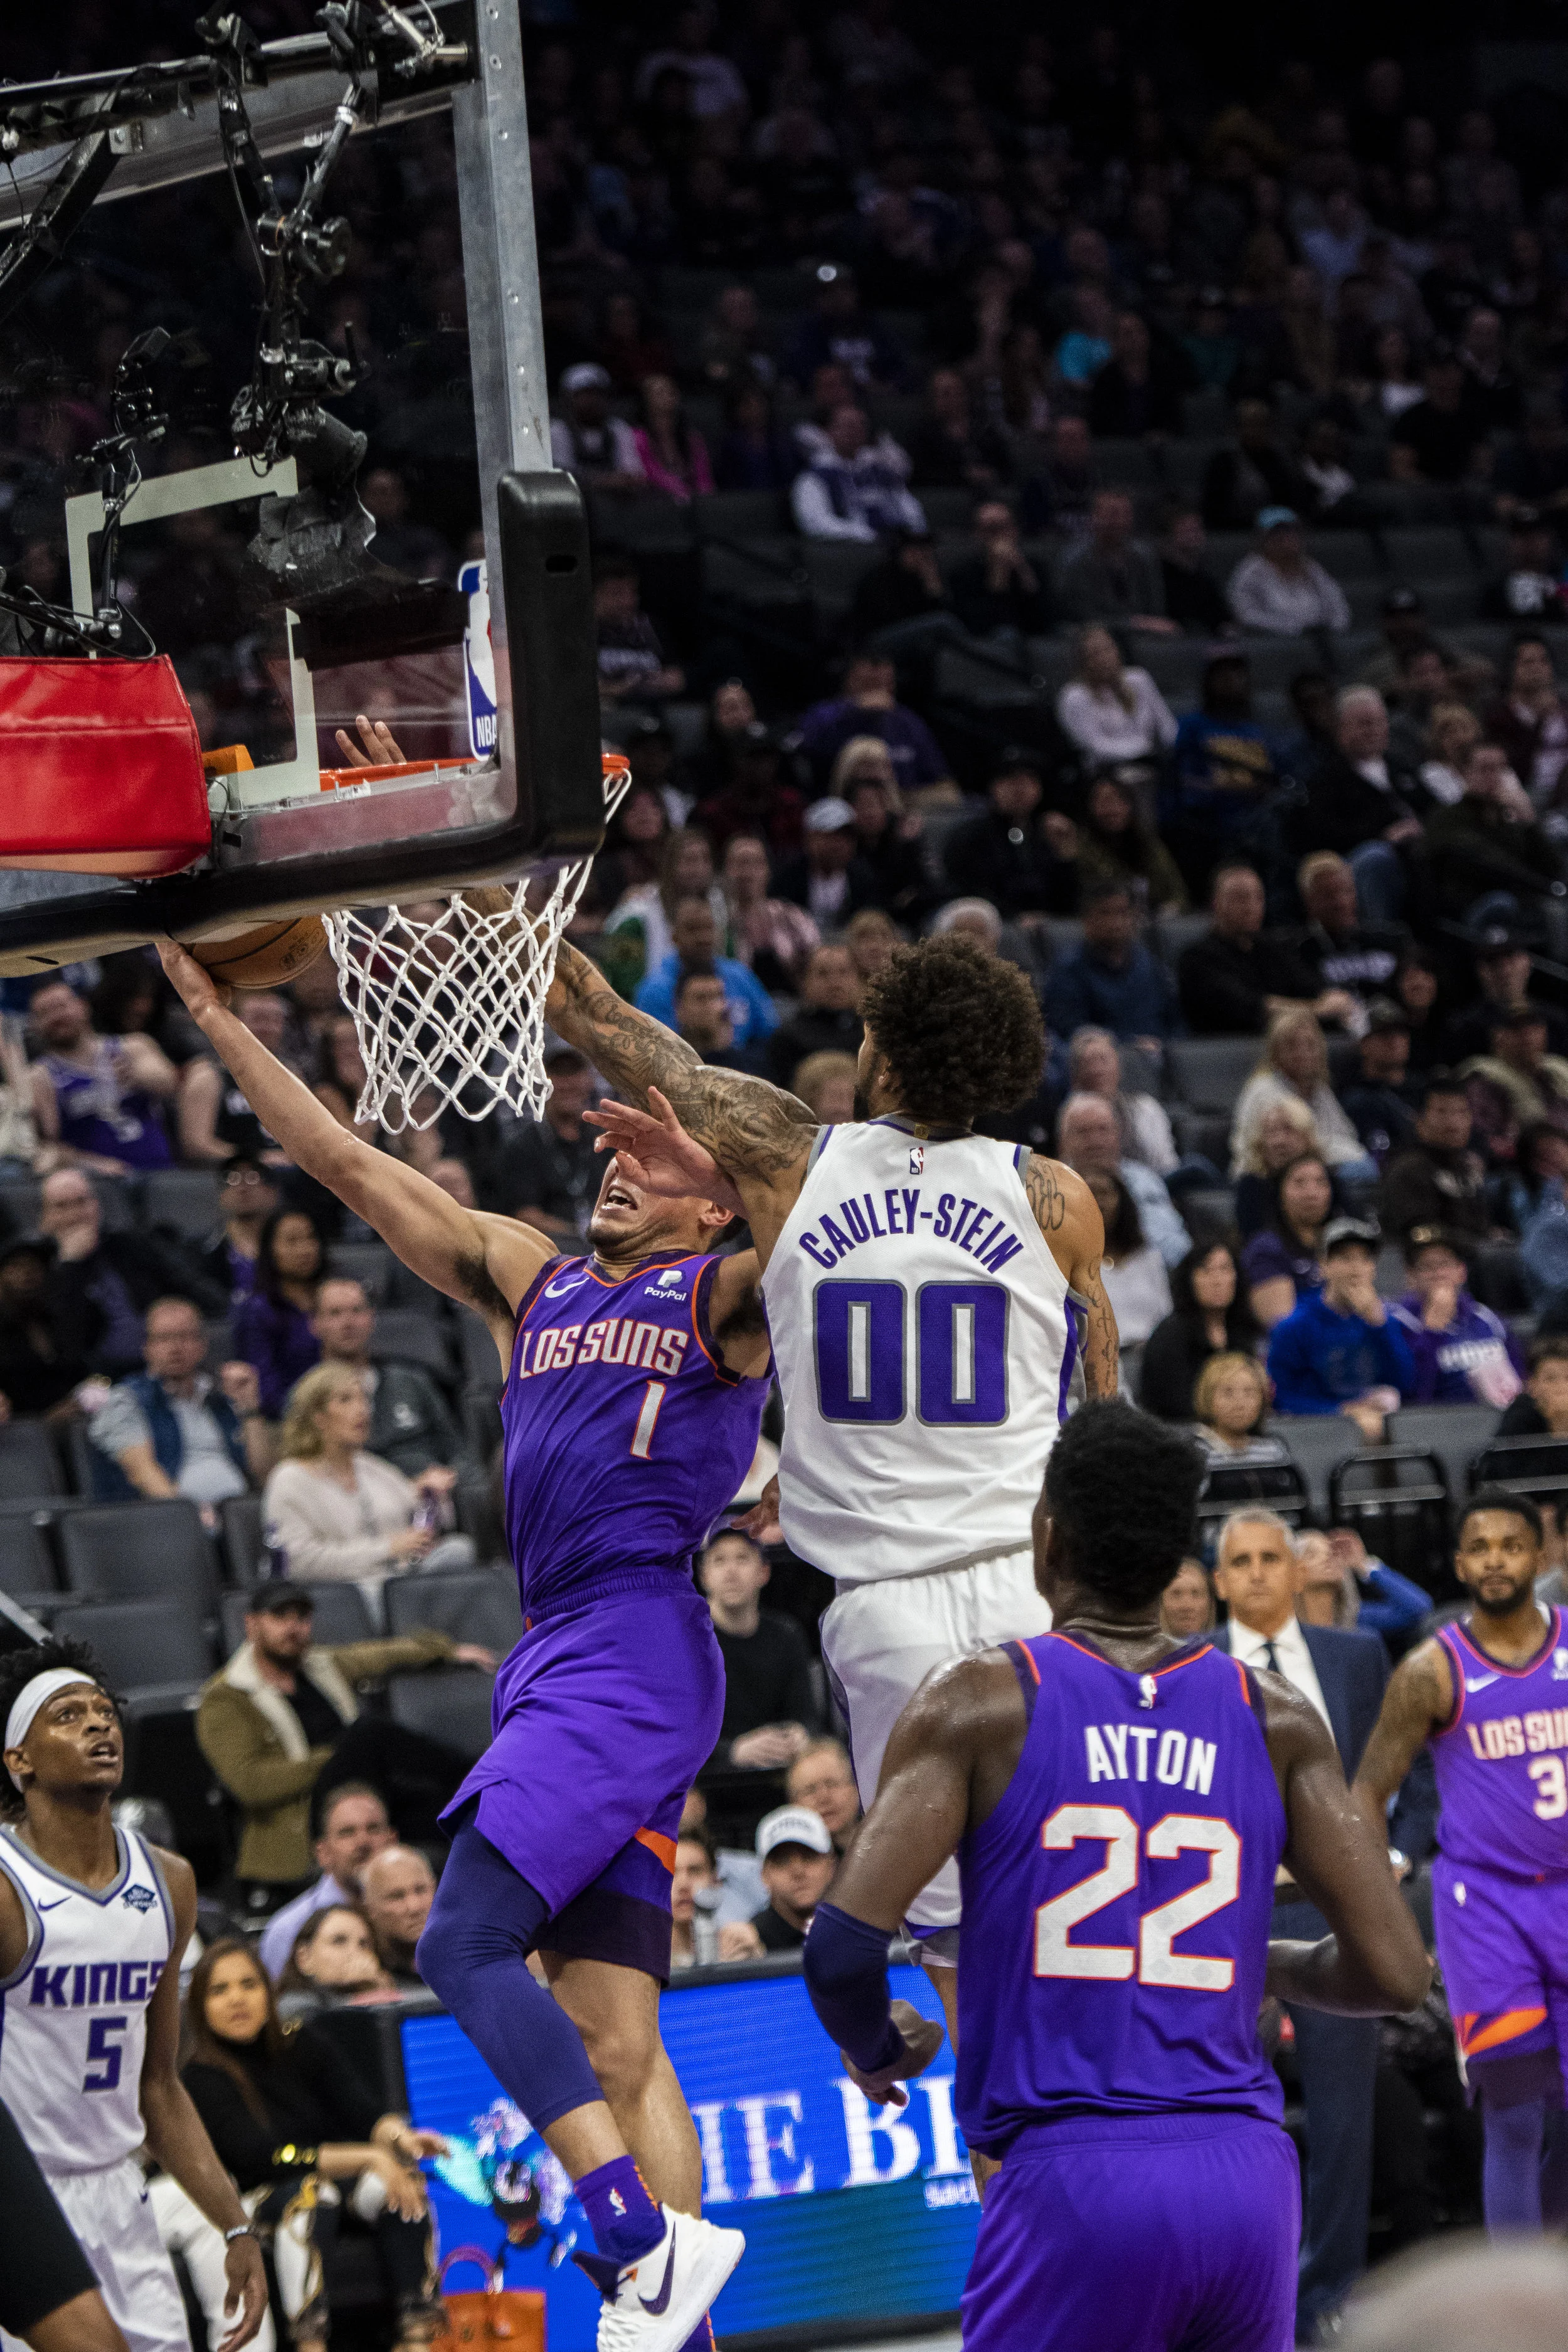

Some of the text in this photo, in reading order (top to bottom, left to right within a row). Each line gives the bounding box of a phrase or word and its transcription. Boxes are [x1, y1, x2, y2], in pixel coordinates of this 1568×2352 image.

[799, 1189, 1024, 1274] CAULEY-STEIN
[644, 1286, 687, 1301] PayPal
[813, 1278, 1012, 1428] 00
[630, 1380, 667, 1460] 1
[1085, 1724, 1217, 1796] AYTON
[1034, 1802, 1243, 1993] 22
[82, 2015, 128, 2094] 5
